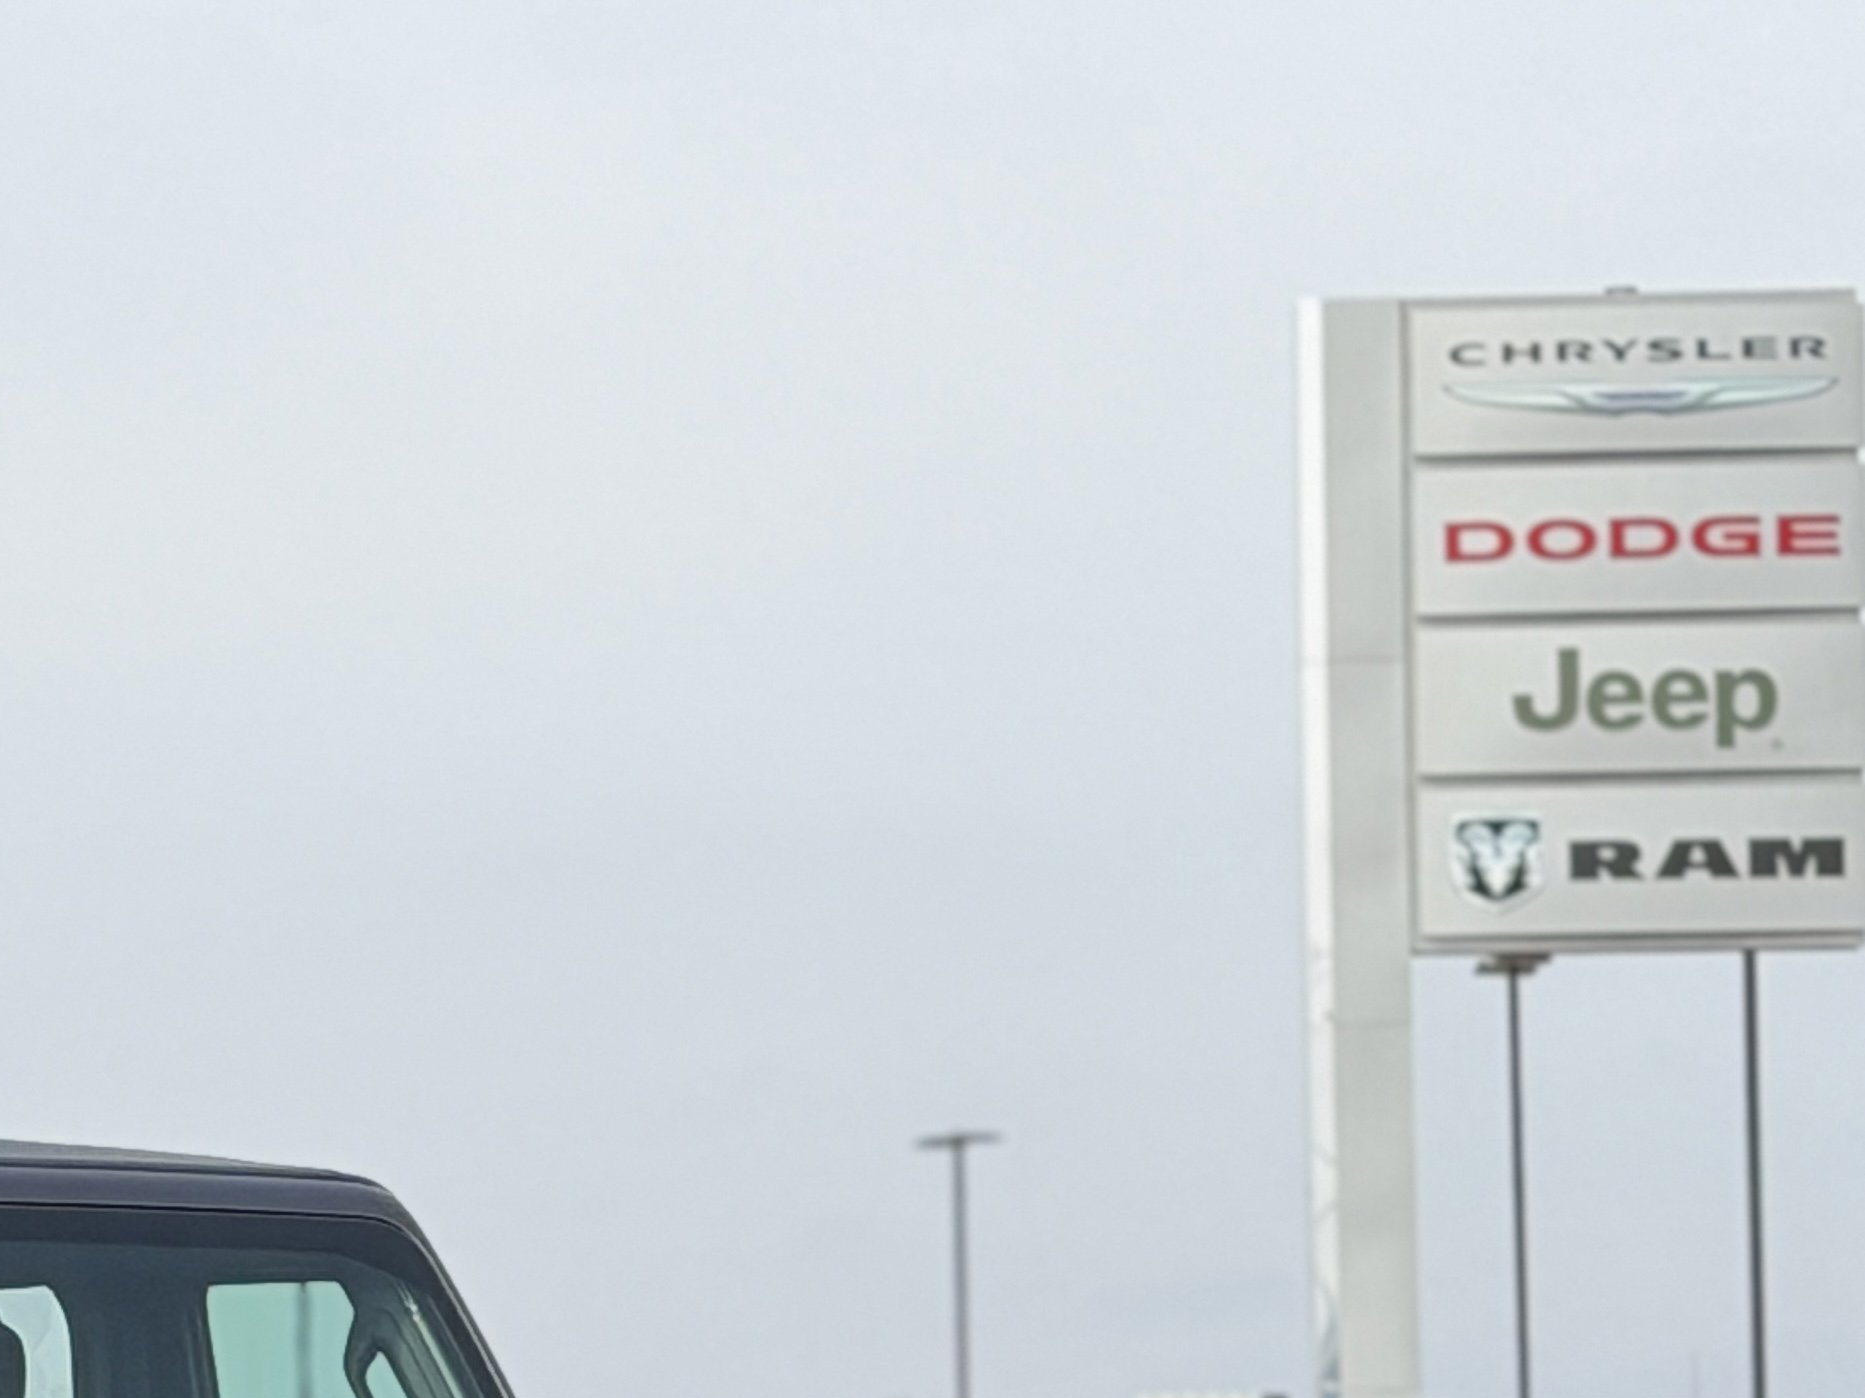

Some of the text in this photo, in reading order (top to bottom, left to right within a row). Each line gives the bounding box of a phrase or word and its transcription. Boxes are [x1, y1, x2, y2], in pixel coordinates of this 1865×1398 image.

[1449, 336, 1828, 367] CHRYSLER
[1444, 514, 1841, 563] DODGE
[1512, 646, 1778, 749] Jeep
[1568, 837, 1846, 881] RAM
